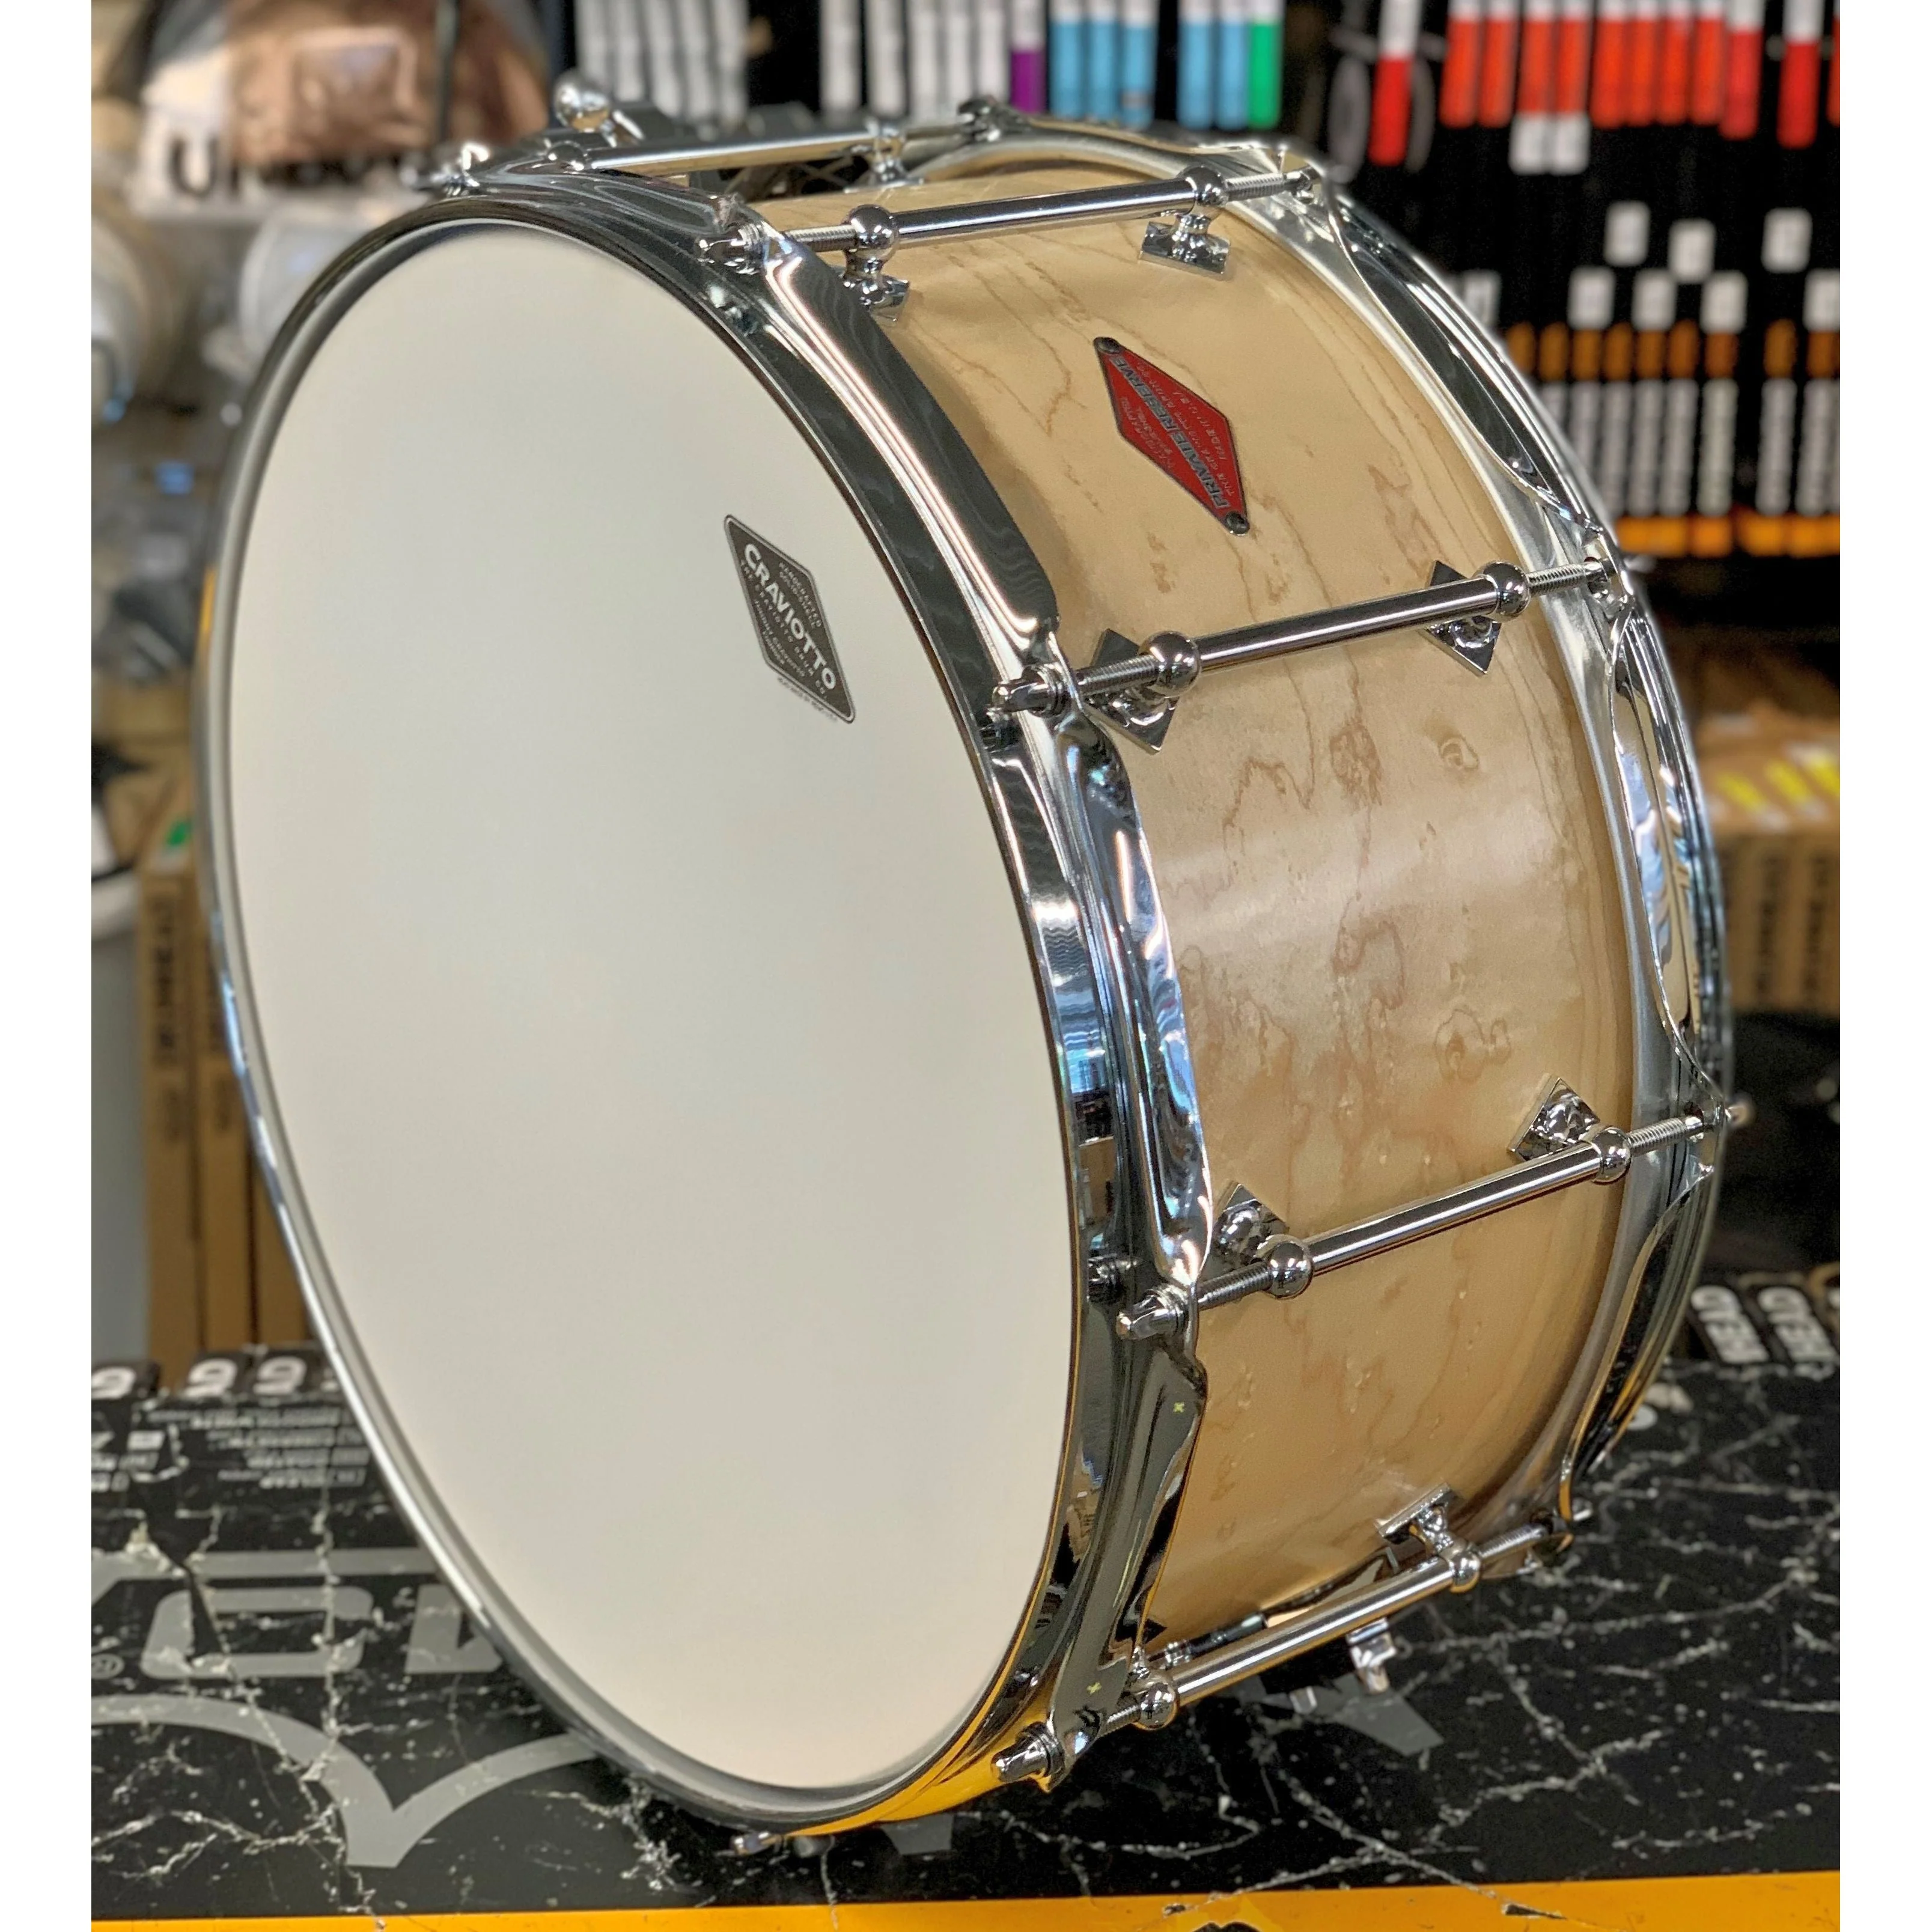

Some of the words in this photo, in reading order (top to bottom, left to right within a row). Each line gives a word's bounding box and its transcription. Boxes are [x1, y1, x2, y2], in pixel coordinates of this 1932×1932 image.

[1108, 355, 1180, 431] RESERVE
[1166, 431, 1230, 508] PRIVATE
[745, 543, 836, 690] CRAVIOTTO
